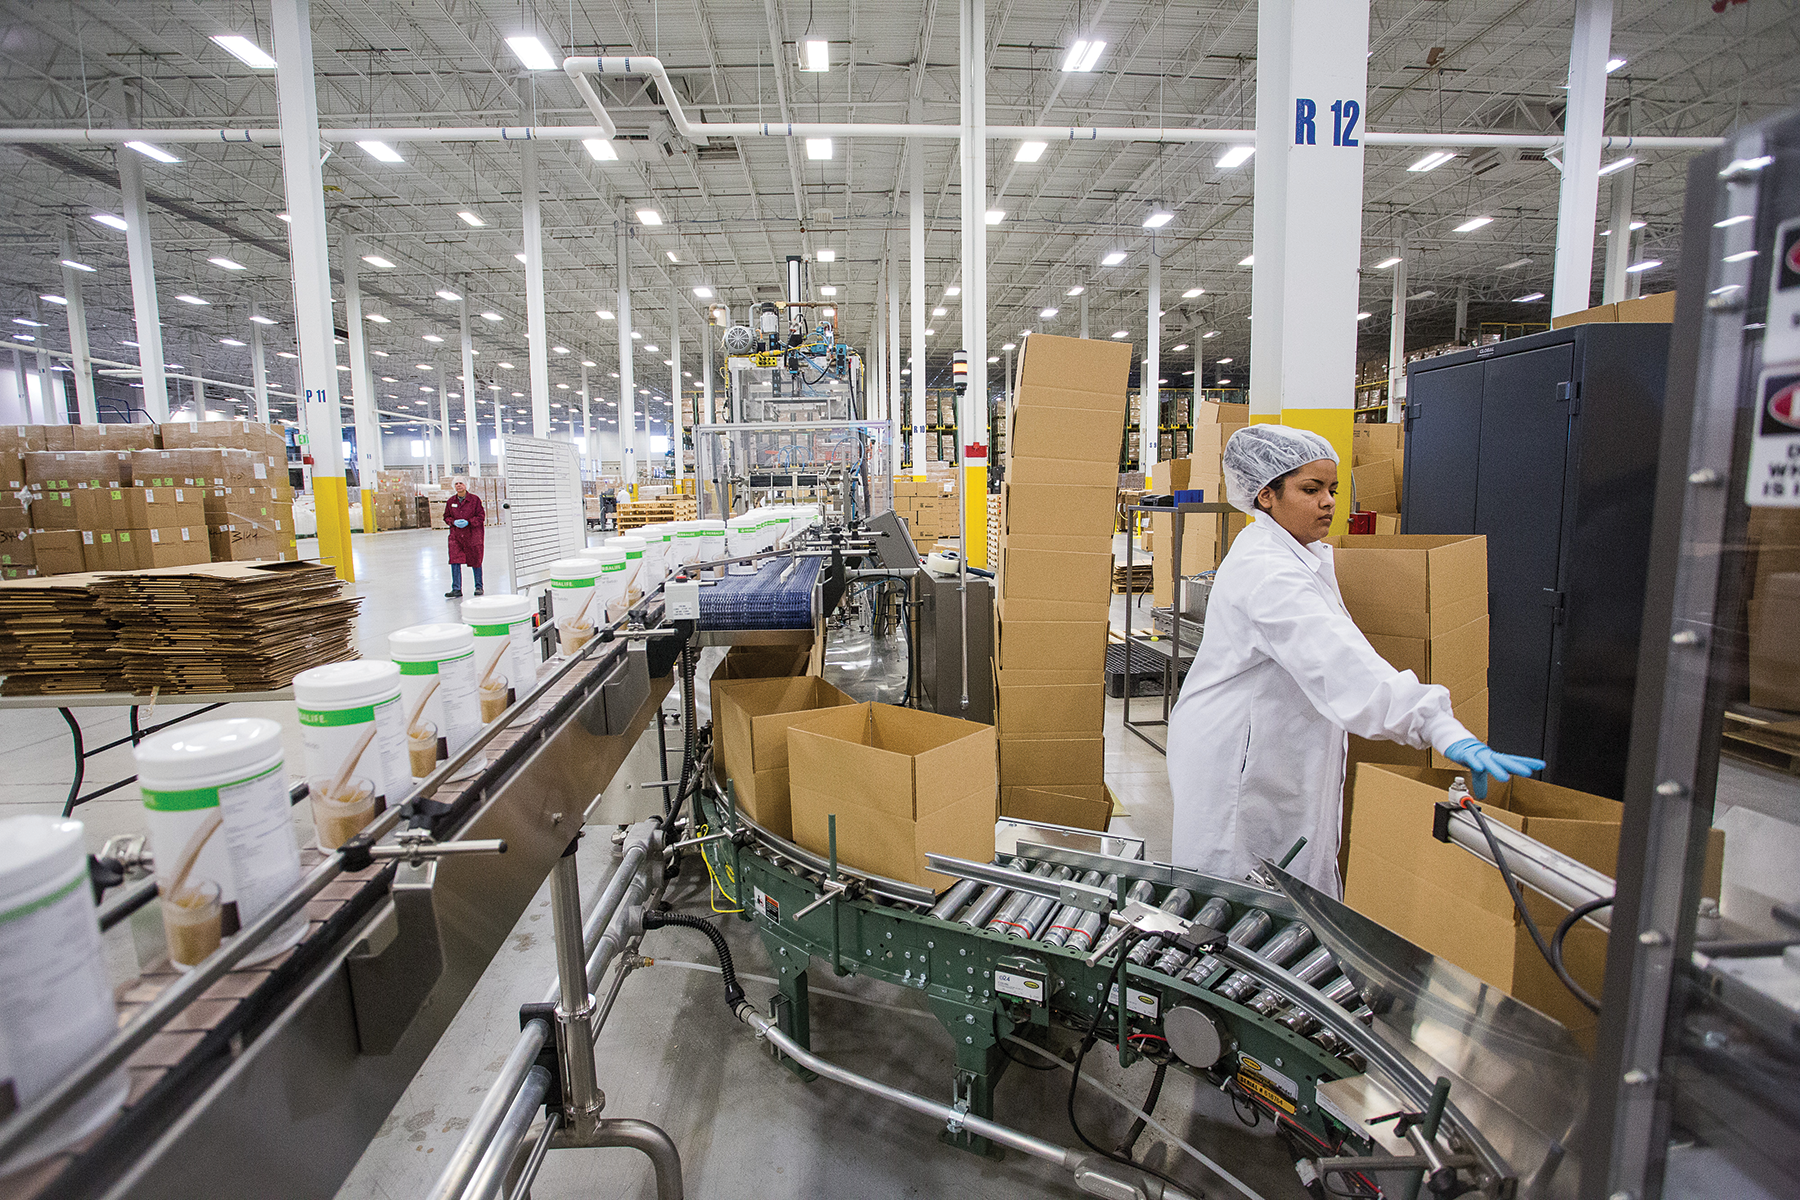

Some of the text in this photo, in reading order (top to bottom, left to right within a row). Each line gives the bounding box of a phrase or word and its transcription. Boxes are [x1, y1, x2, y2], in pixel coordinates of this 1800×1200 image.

[1295, 98, 1360, 147] R 12
[306, 389, 327, 403] P 11
[913, 425, 919, 433] R
